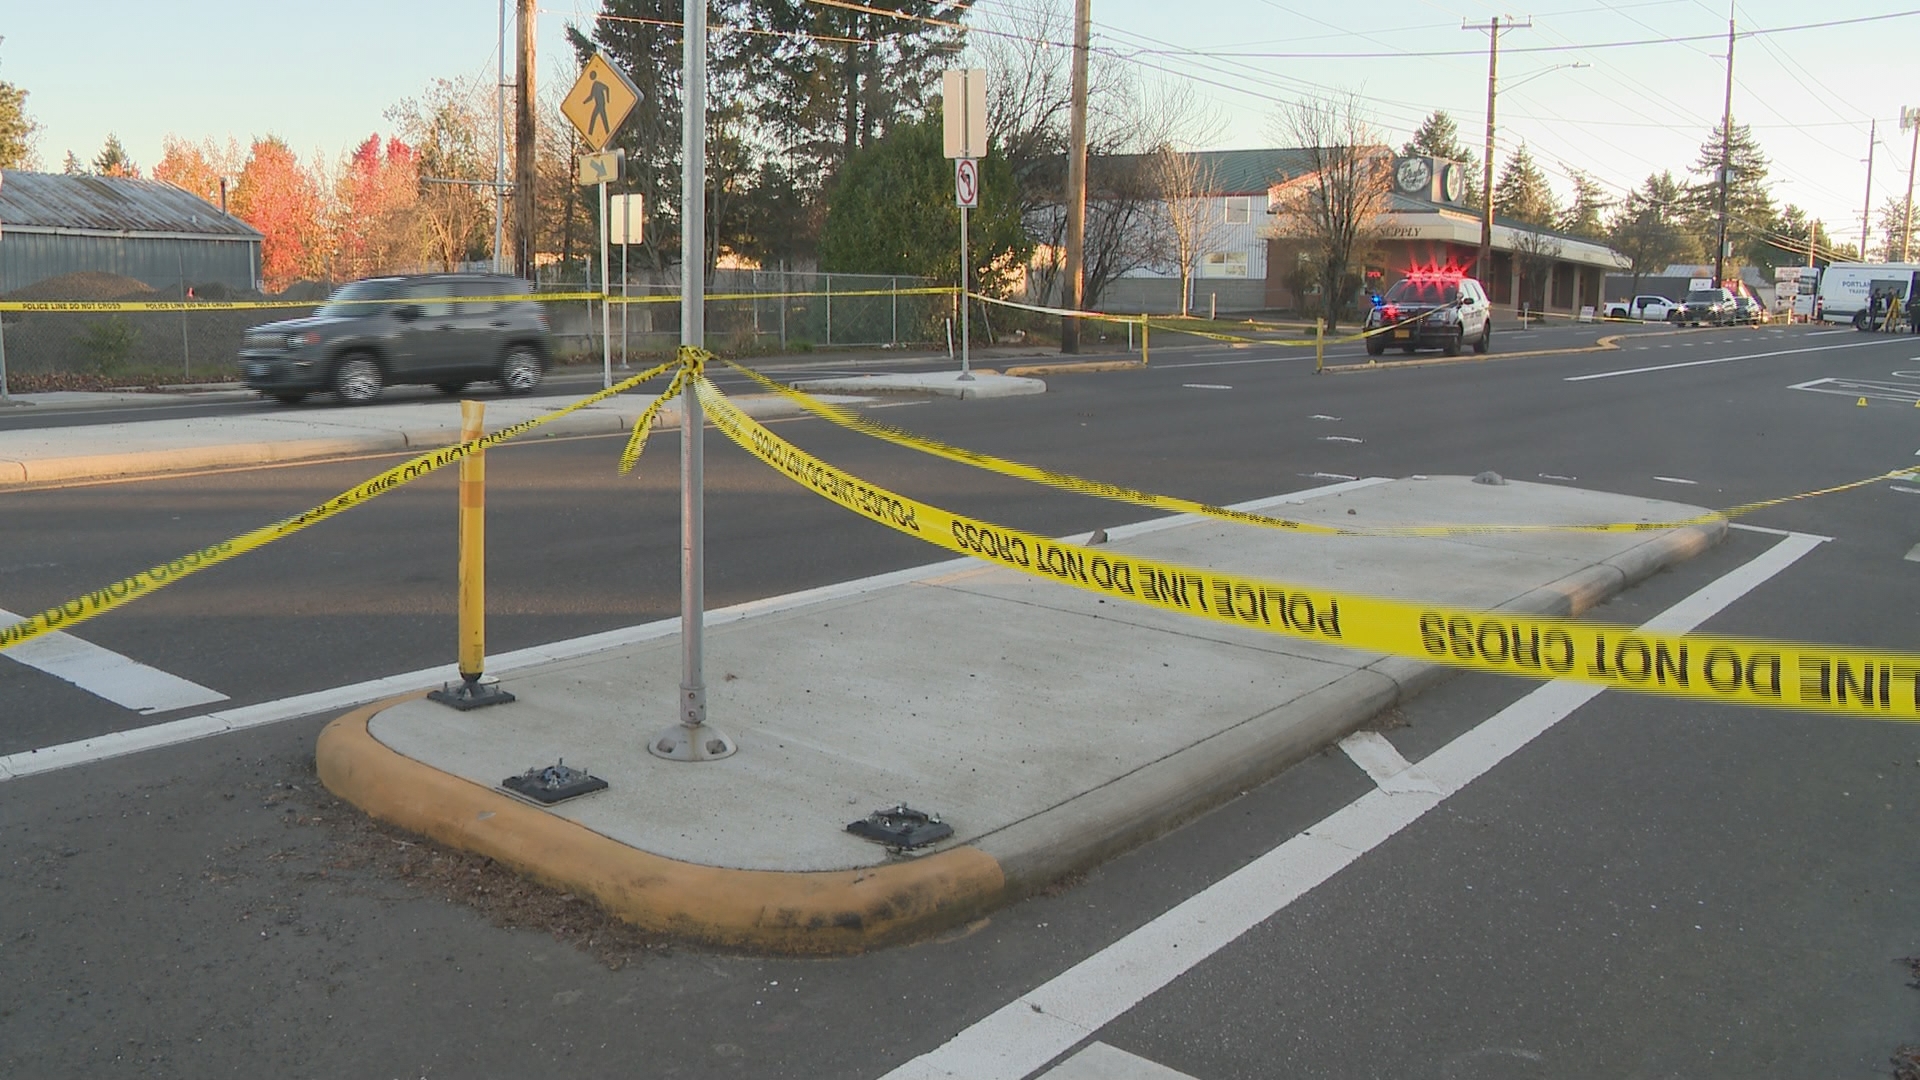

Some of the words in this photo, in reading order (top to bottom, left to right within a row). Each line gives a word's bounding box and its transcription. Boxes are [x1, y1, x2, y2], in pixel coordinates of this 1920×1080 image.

[751, 428, 784, 467] CROSS
[783, 449, 809, 481] NOT
[806, 462, 828, 492] DO
[826, 472, 860, 507] LINE
[857, 486, 920, 532] POLICE
[951, 520, 1031, 567] CROSS
[1037, 542, 1089, 584] NOT
[1091, 556, 1135, 595] DO
[1138, 565, 1208, 613] LINE
[1212, 579, 1342, 639] POLICE
[1419, 610, 1575, 673] CROSS
[1587, 632, 1690, 688] NOT
[1704, 645, 1783, 698] DO
